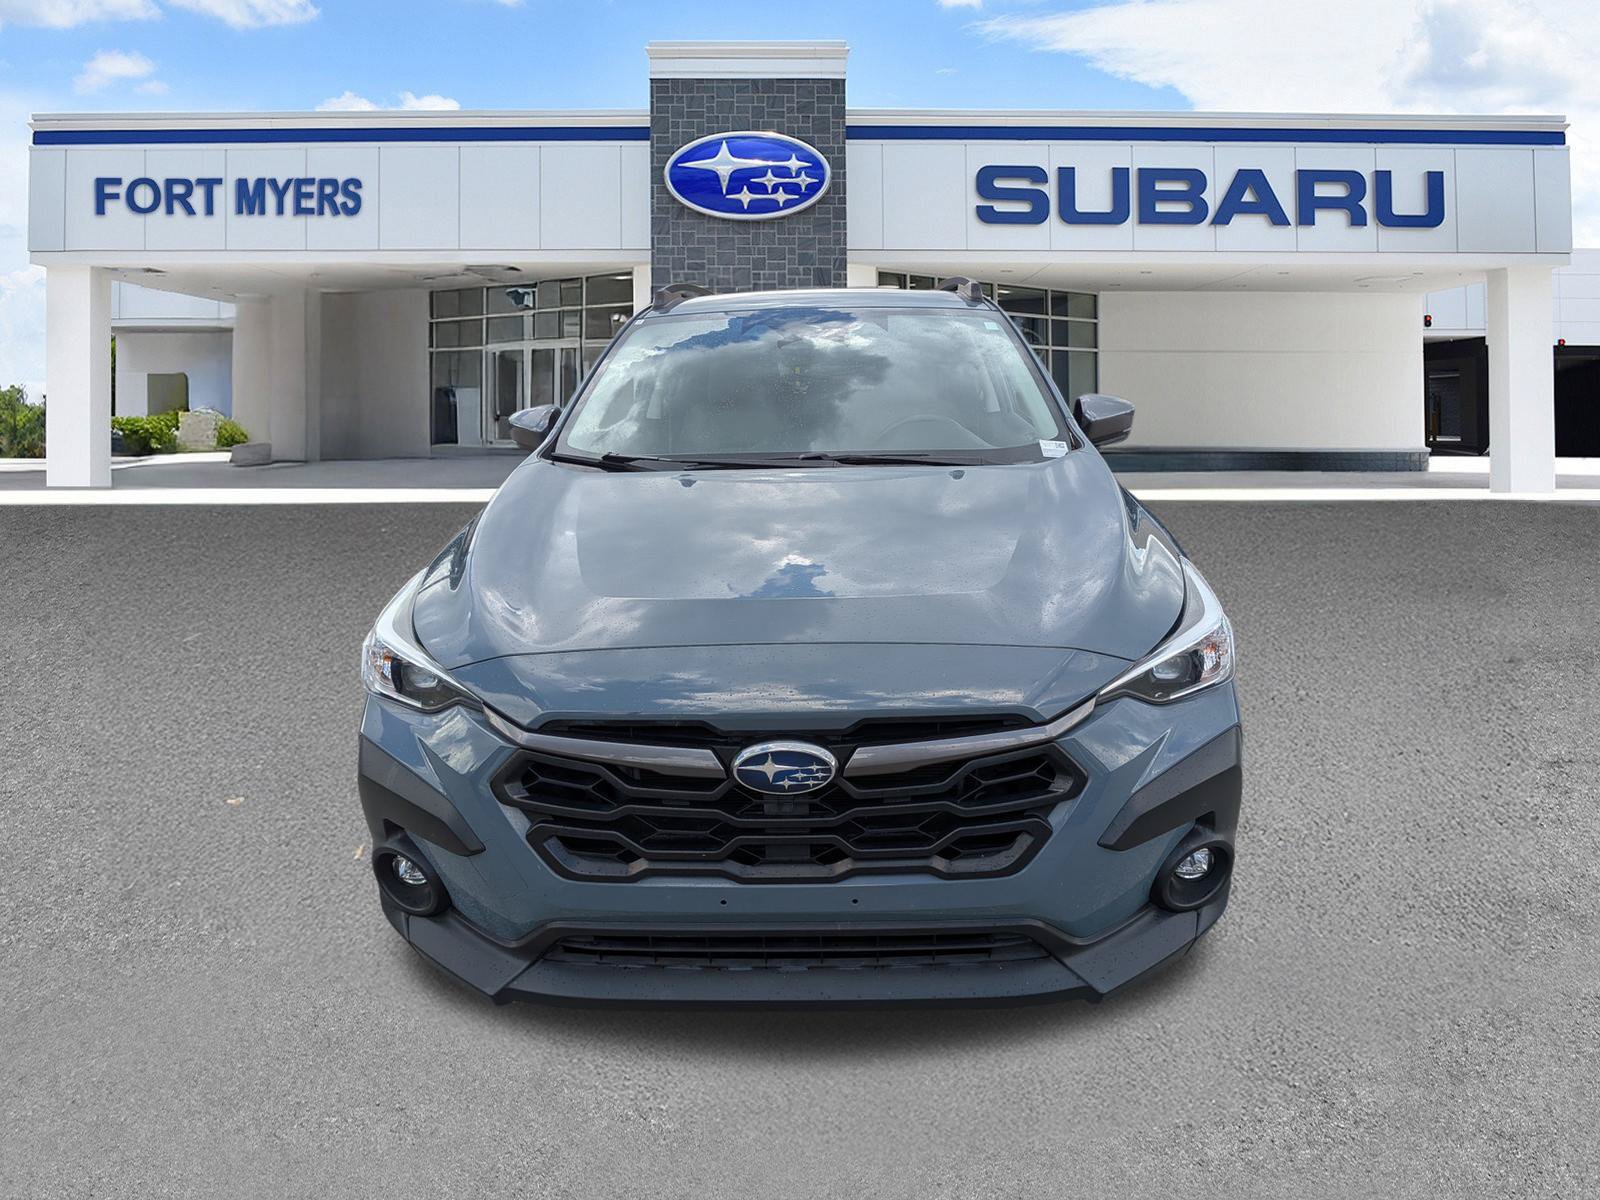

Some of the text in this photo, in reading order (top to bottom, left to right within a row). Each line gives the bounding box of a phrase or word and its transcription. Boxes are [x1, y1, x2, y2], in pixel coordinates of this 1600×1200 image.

[94, 177, 363, 217] FORT MYERS
[975, 164, 1446, 228] SUBARU
